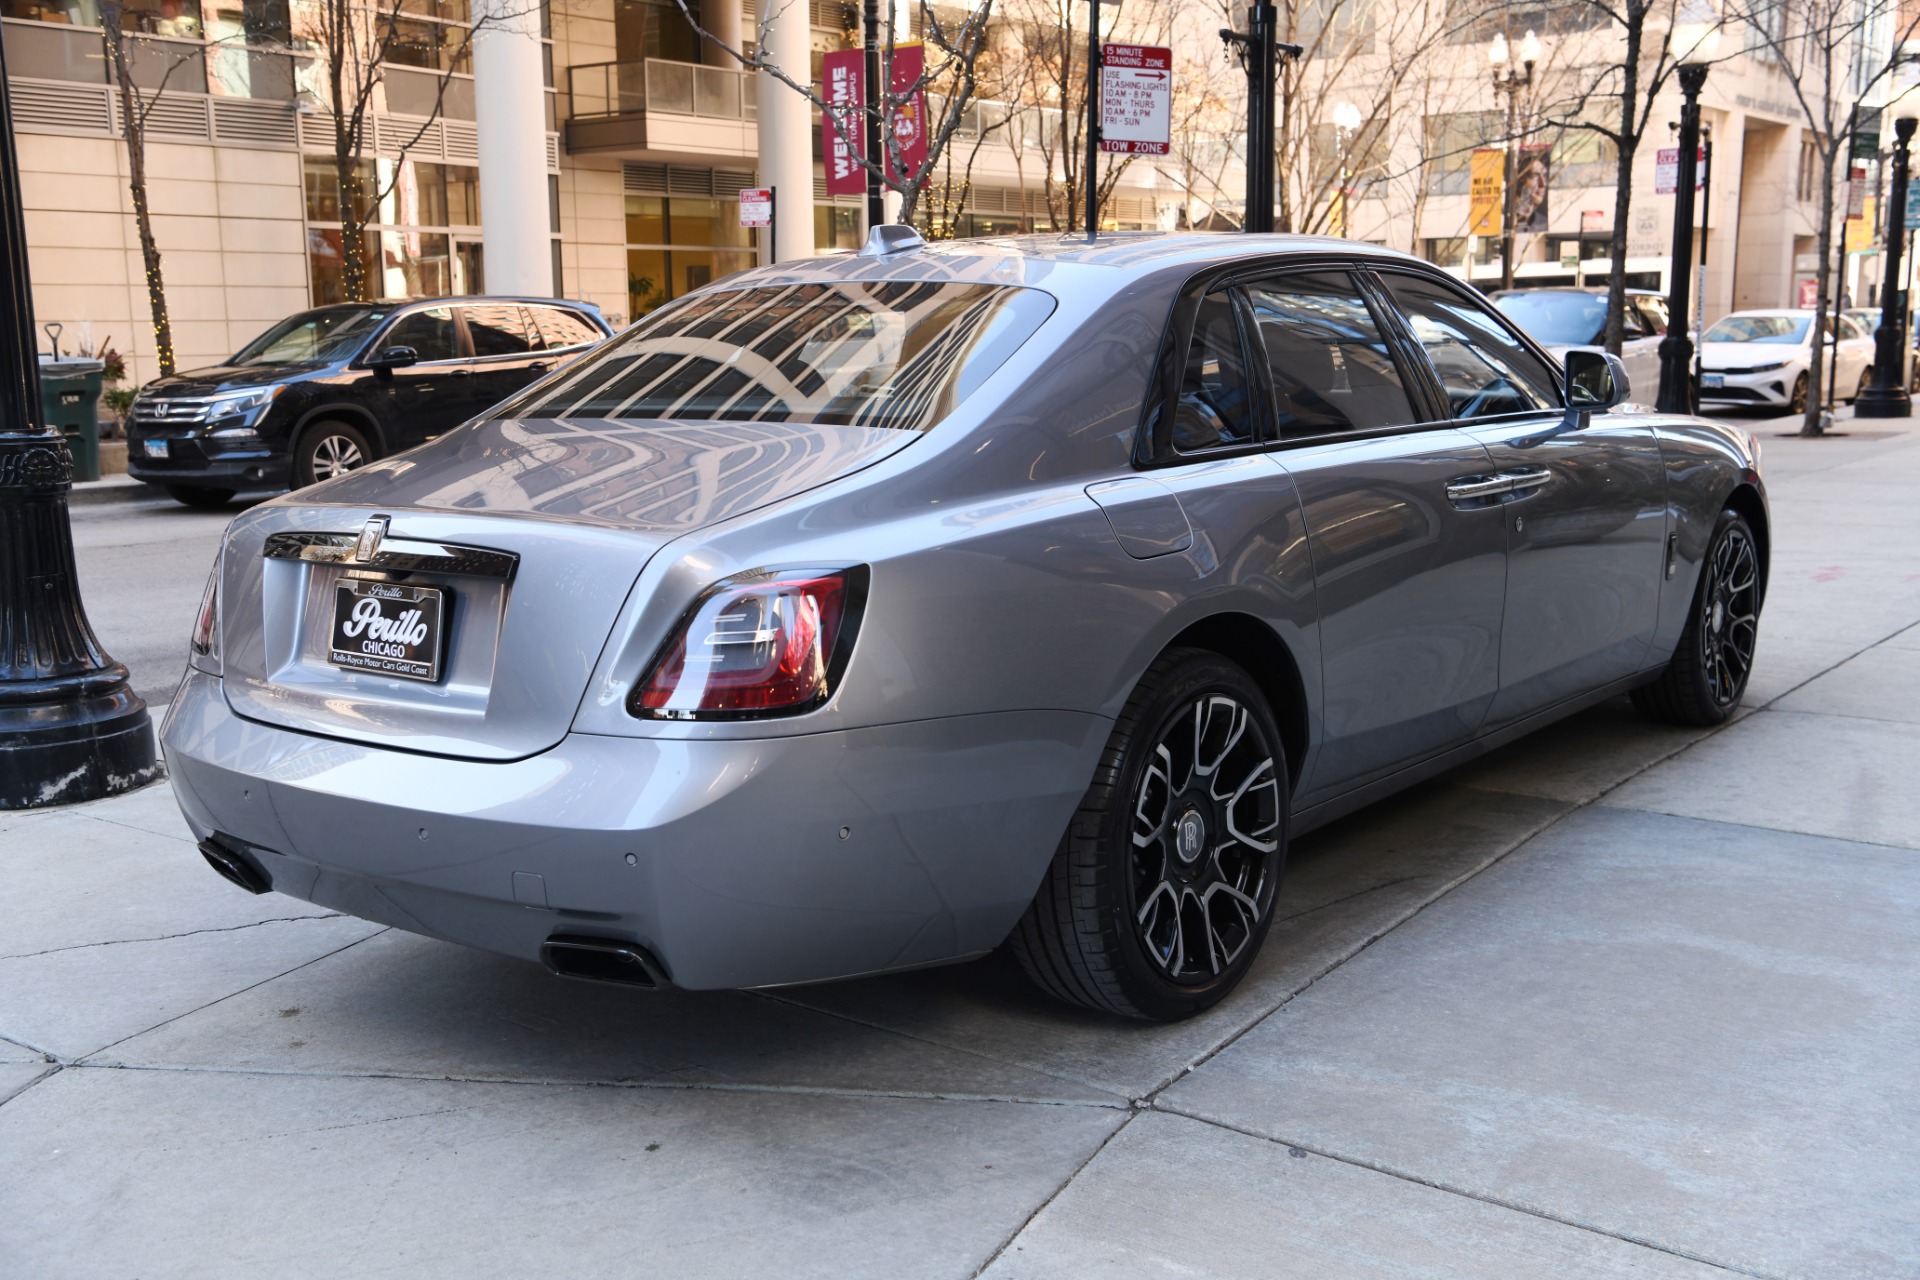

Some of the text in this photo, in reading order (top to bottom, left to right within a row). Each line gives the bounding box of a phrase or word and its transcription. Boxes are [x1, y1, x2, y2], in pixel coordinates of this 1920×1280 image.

[1106, 46, 1143, 57] 15 MINUTE
[1106, 56, 1165, 68] STANDING ZONE
[1105, 70, 1120, 79] USE
[849, 72, 857, 102] AMPUS
[1105, 80, 1167, 92] FLASHING LIGHTS
[1105, 89, 1114, 97] 10
[1114, 89, 1126, 98] AM
[1133, 91, 1139, 99] 8
[1140, 91, 1152, 99] PM
[1105, 98, 1122, 107] MON
[1130, 100, 1155, 108] THURS
[1105, 107, 1113, 115] 10
[1113, 108, 1125, 116] AM
[1132, 109, 1138, 117] 6
[1139, 109, 1151, 117] PM
[1105, 116, 1117, 124] FRI
[1124, 118, 1140, 126] SUN
[1105, 140, 1163, 153] TOW ZONE
[368, 583, 403, 598] Perillo
[343, 598, 428, 646] Perillo
[362, 640, 405, 658] CHICAGO
[333, 653, 427, 675] Rolls-Royce Motor Cars Gold Coast
